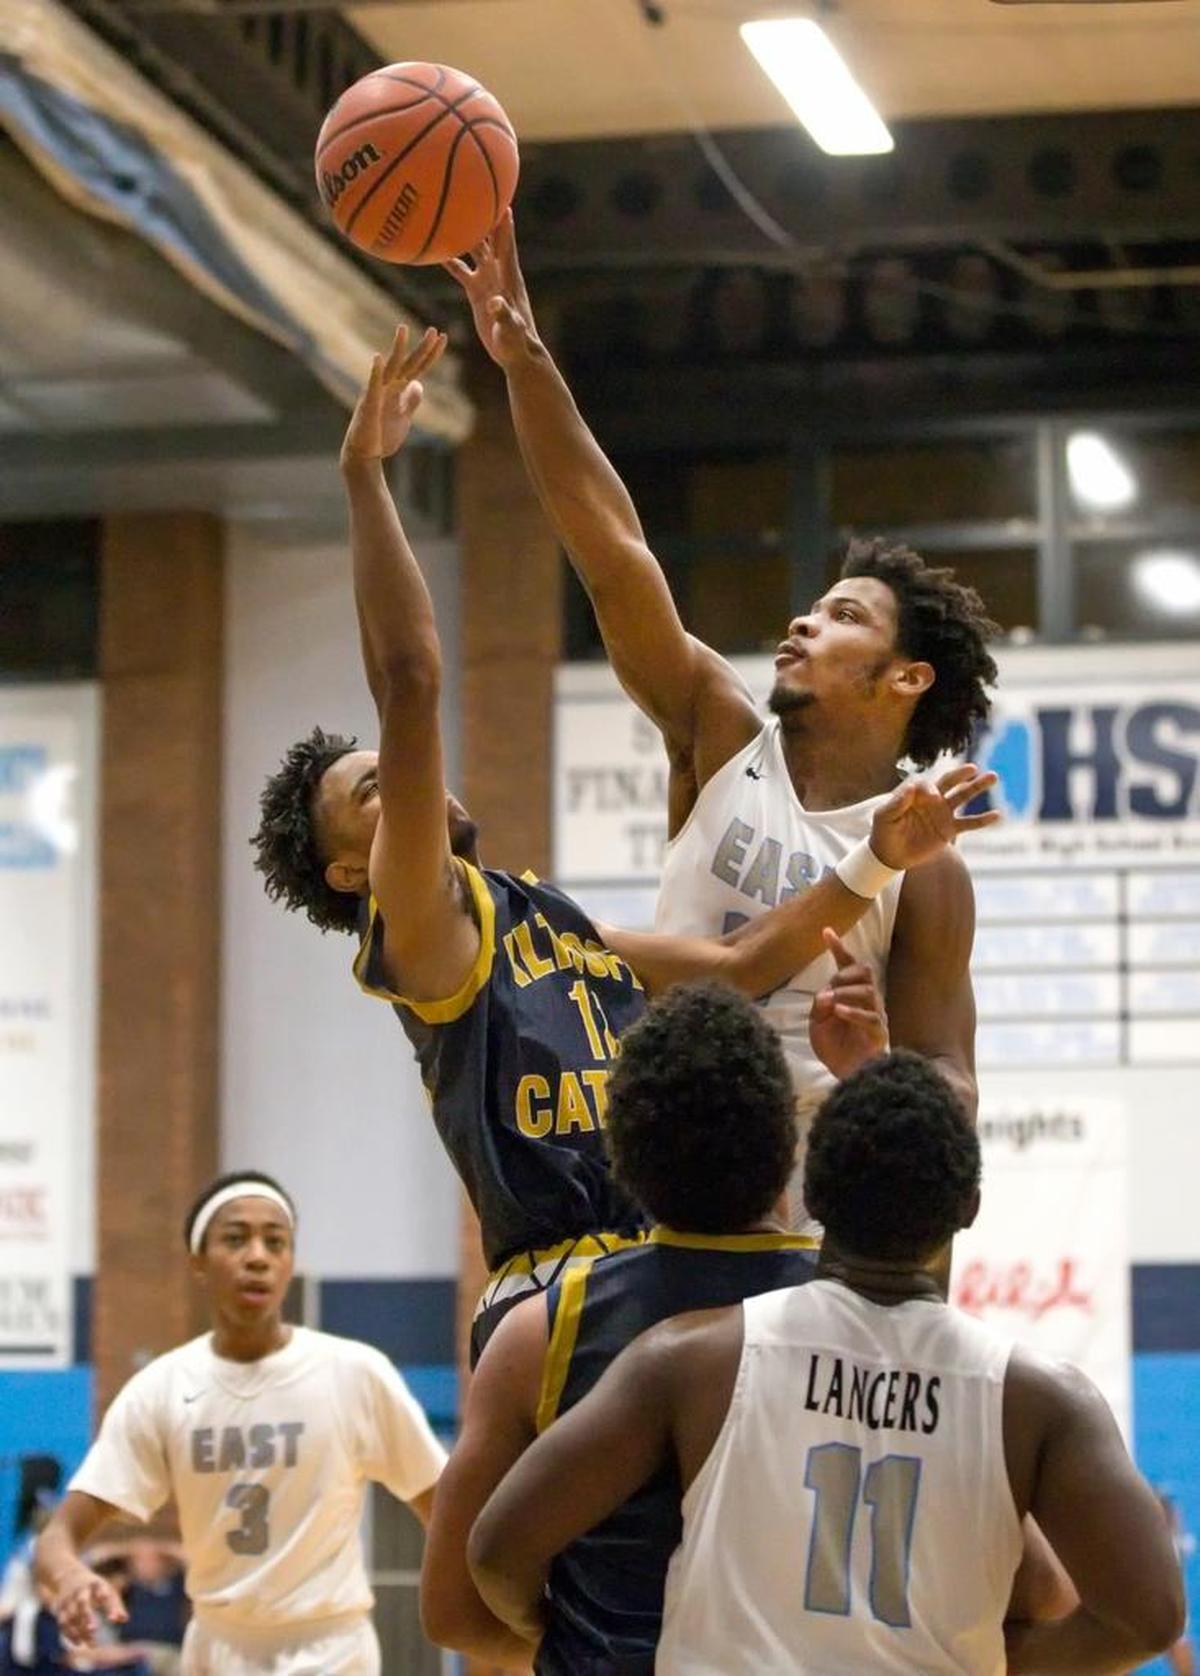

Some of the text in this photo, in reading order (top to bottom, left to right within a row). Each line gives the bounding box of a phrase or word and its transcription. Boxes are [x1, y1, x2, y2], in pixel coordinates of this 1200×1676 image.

[711, 817, 836, 907] EAS
[804, 1354, 941, 1434] LANCERS
[192, 1421, 305, 1473] EAST
[226, 1483, 270, 1556] 3
[803, 1441, 922, 1628] 11
